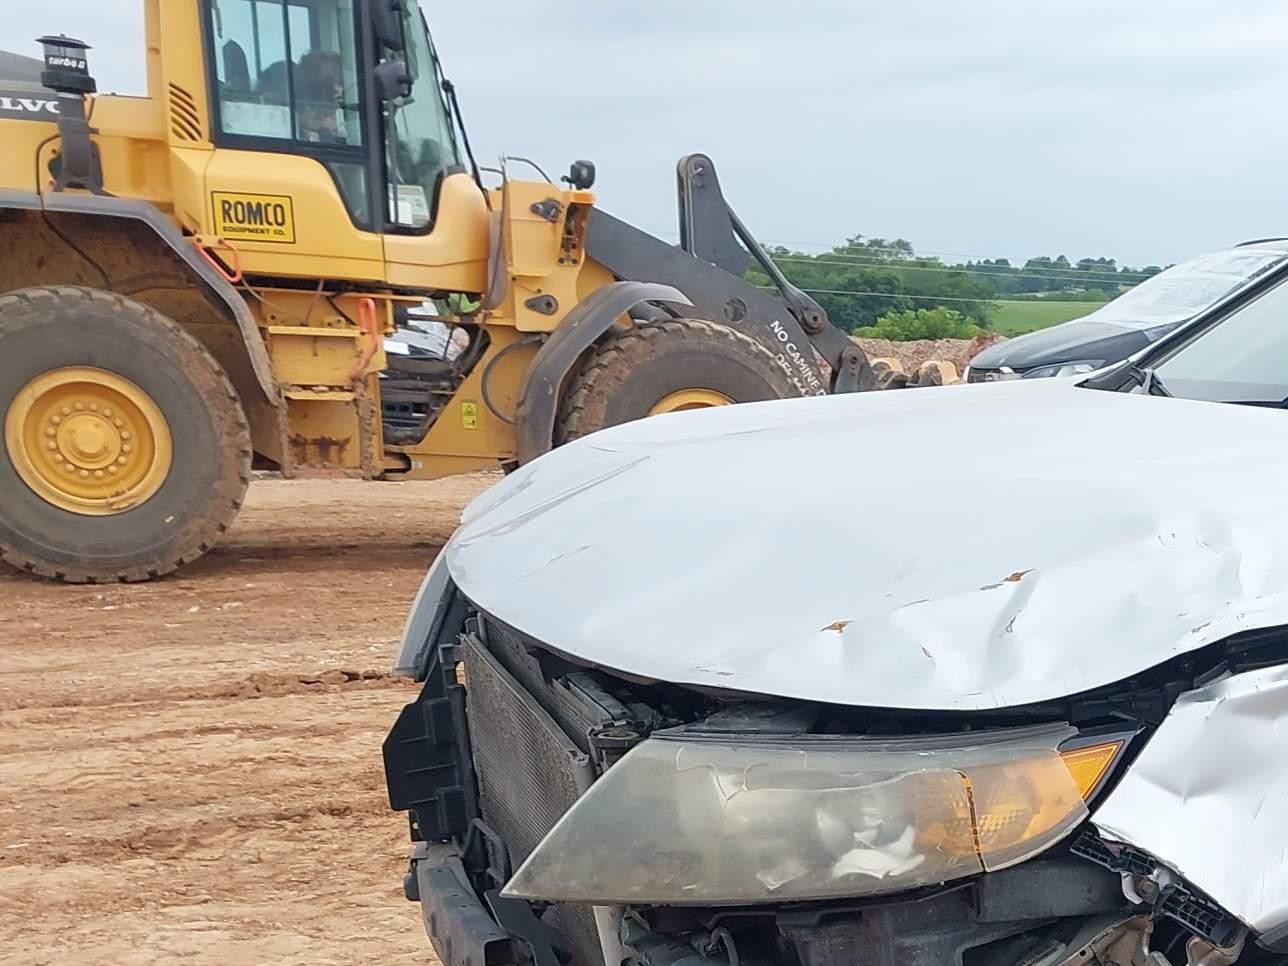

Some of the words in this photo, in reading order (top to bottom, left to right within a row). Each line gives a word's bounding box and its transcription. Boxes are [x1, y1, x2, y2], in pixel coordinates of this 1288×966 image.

[49, 57, 77, 68] turbo
[221, 199, 286, 227] ROMCO
[223, 226, 270, 235] EQUIPMENT
[769, 320, 789, 342] NO
[785, 343, 822, 390] CAMINE
